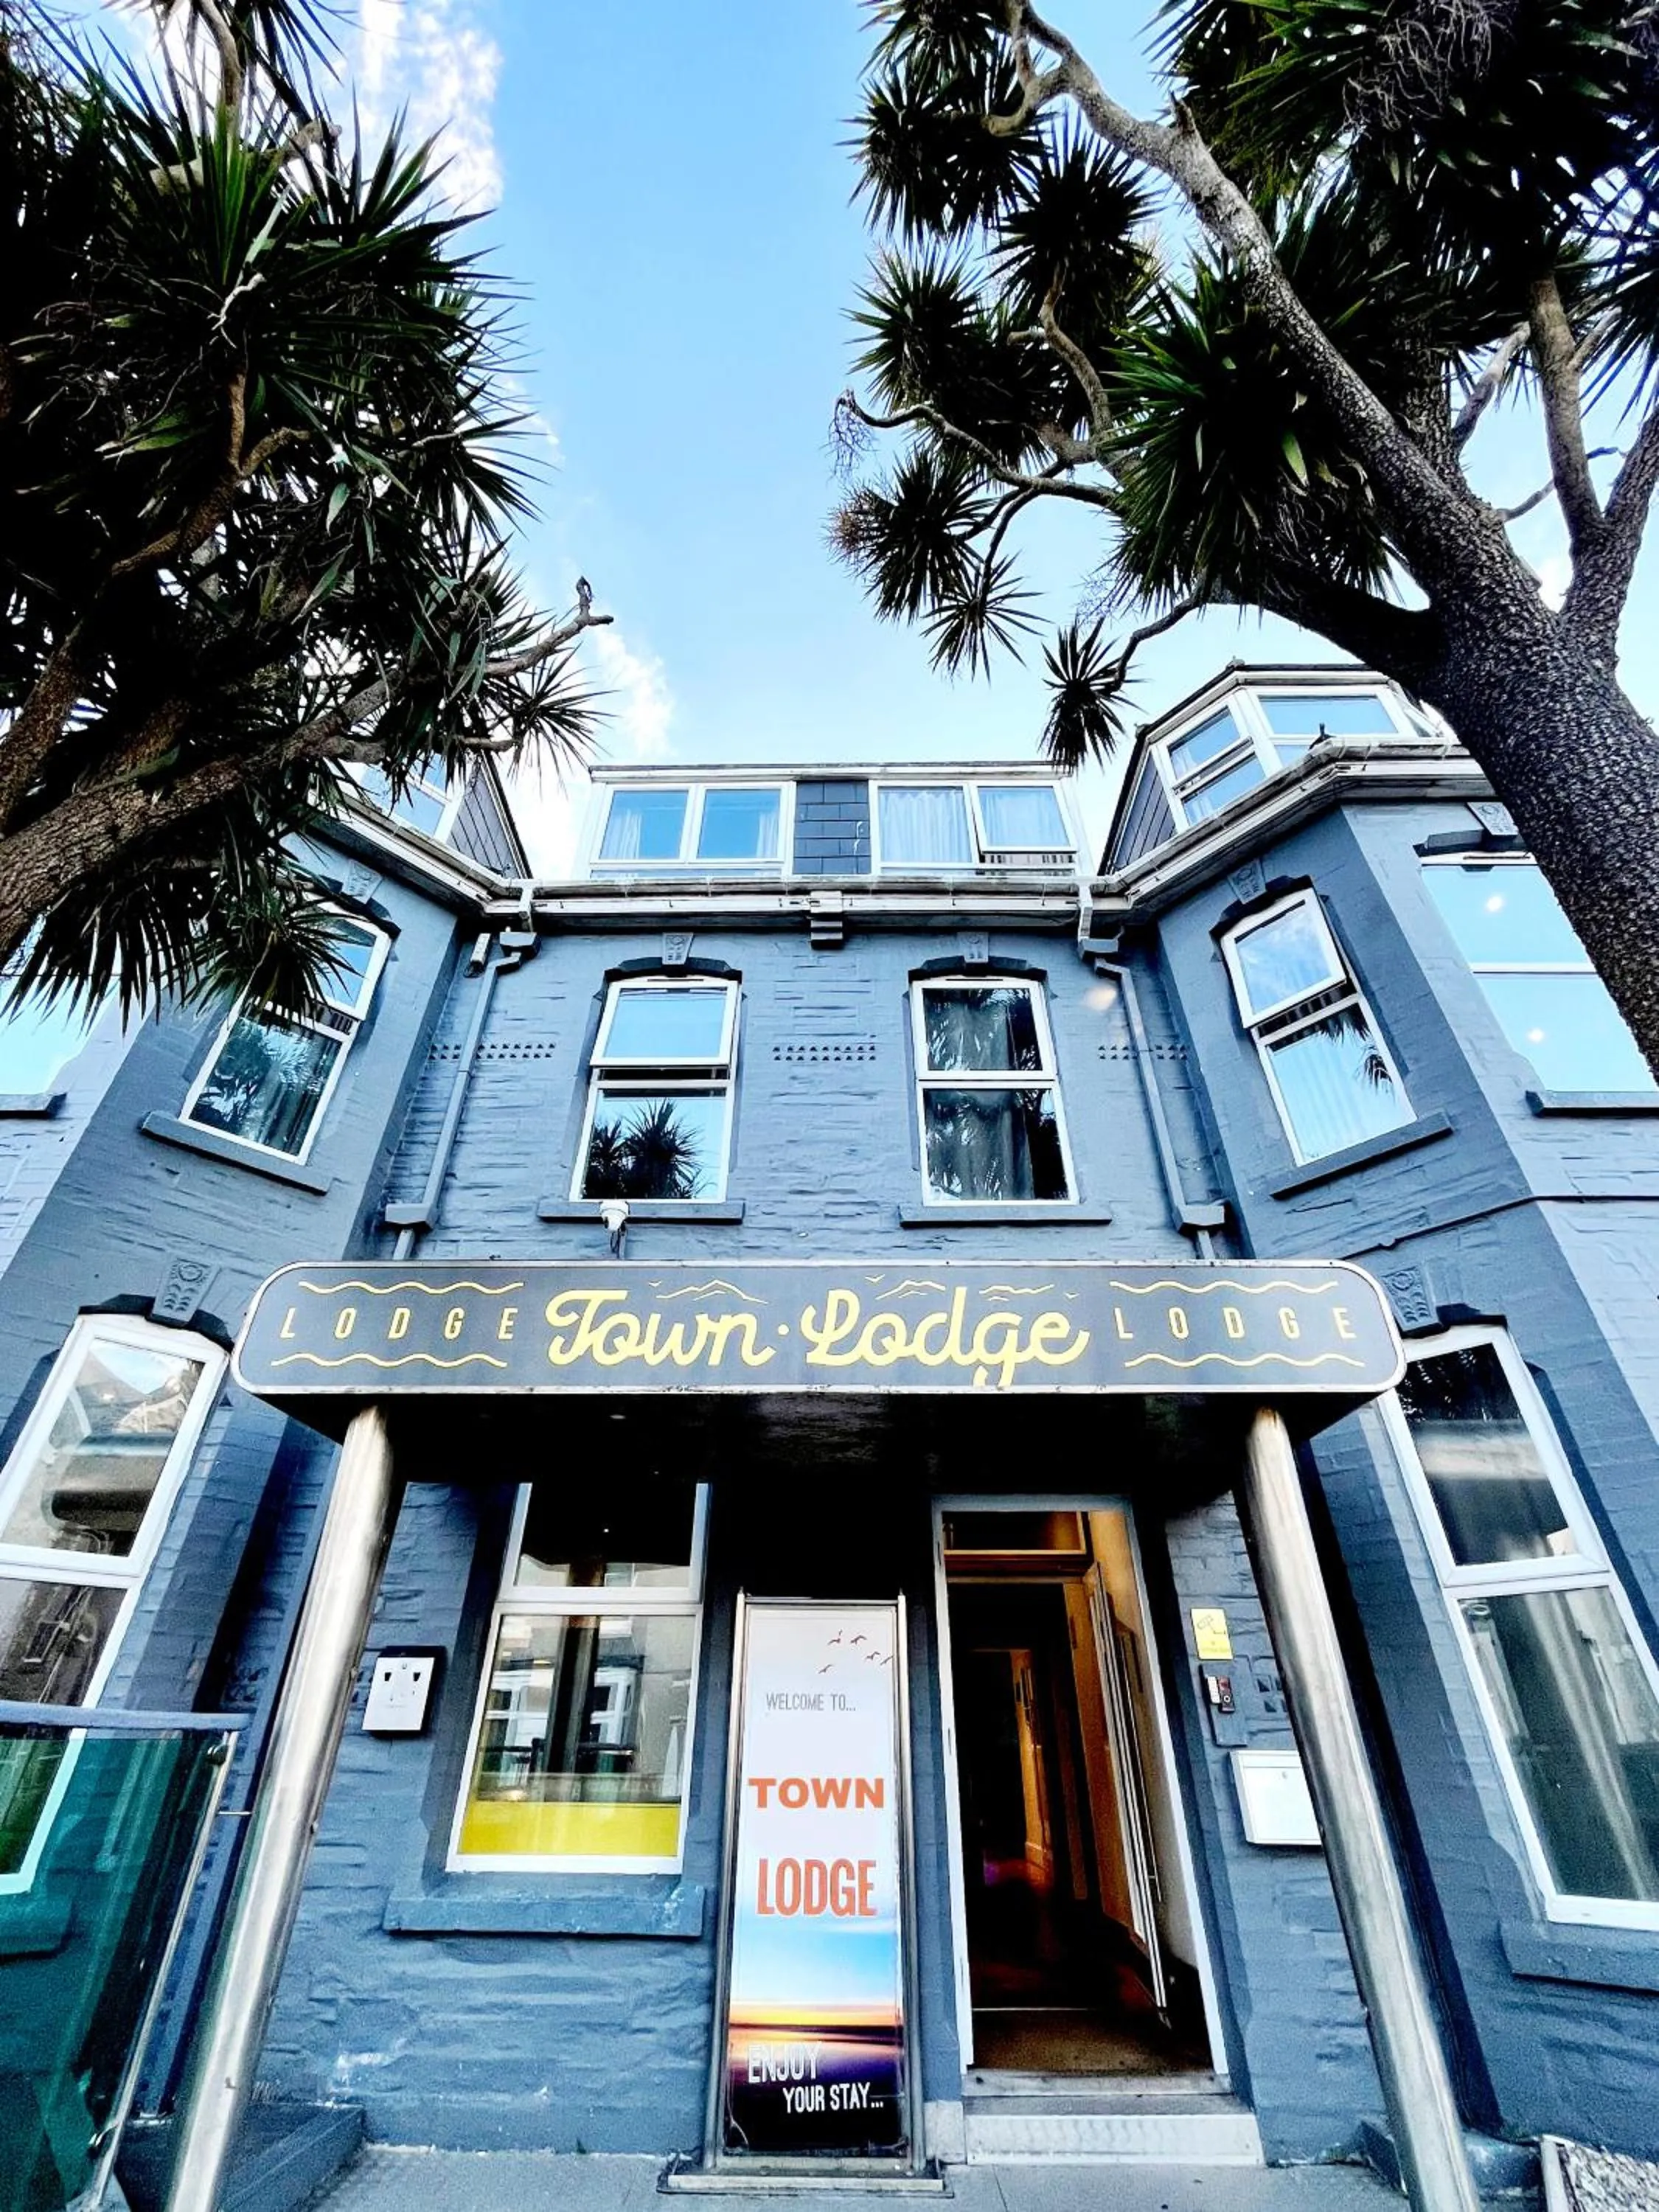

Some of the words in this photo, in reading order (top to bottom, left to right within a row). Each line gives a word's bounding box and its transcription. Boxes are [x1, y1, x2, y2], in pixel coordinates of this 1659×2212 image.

[280, 1307, 518, 1340] LODGE
[544, 1289, 776, 1366] Town
[799, 1287, 1091, 1388] Lodge
[1113, 1307, 1356, 1340] LODGE
[765, 1693, 824, 1711] WELCOME
[831, 1694, 857, 1712] TO...
[748, 1778, 885, 1809] TOWN
[757, 1857, 877, 1916] LODGE
[748, 2041, 823, 2083] ENJOY
[783, 2085, 825, 2113] YOUR
[830, 2081, 884, 2110] STAY...
